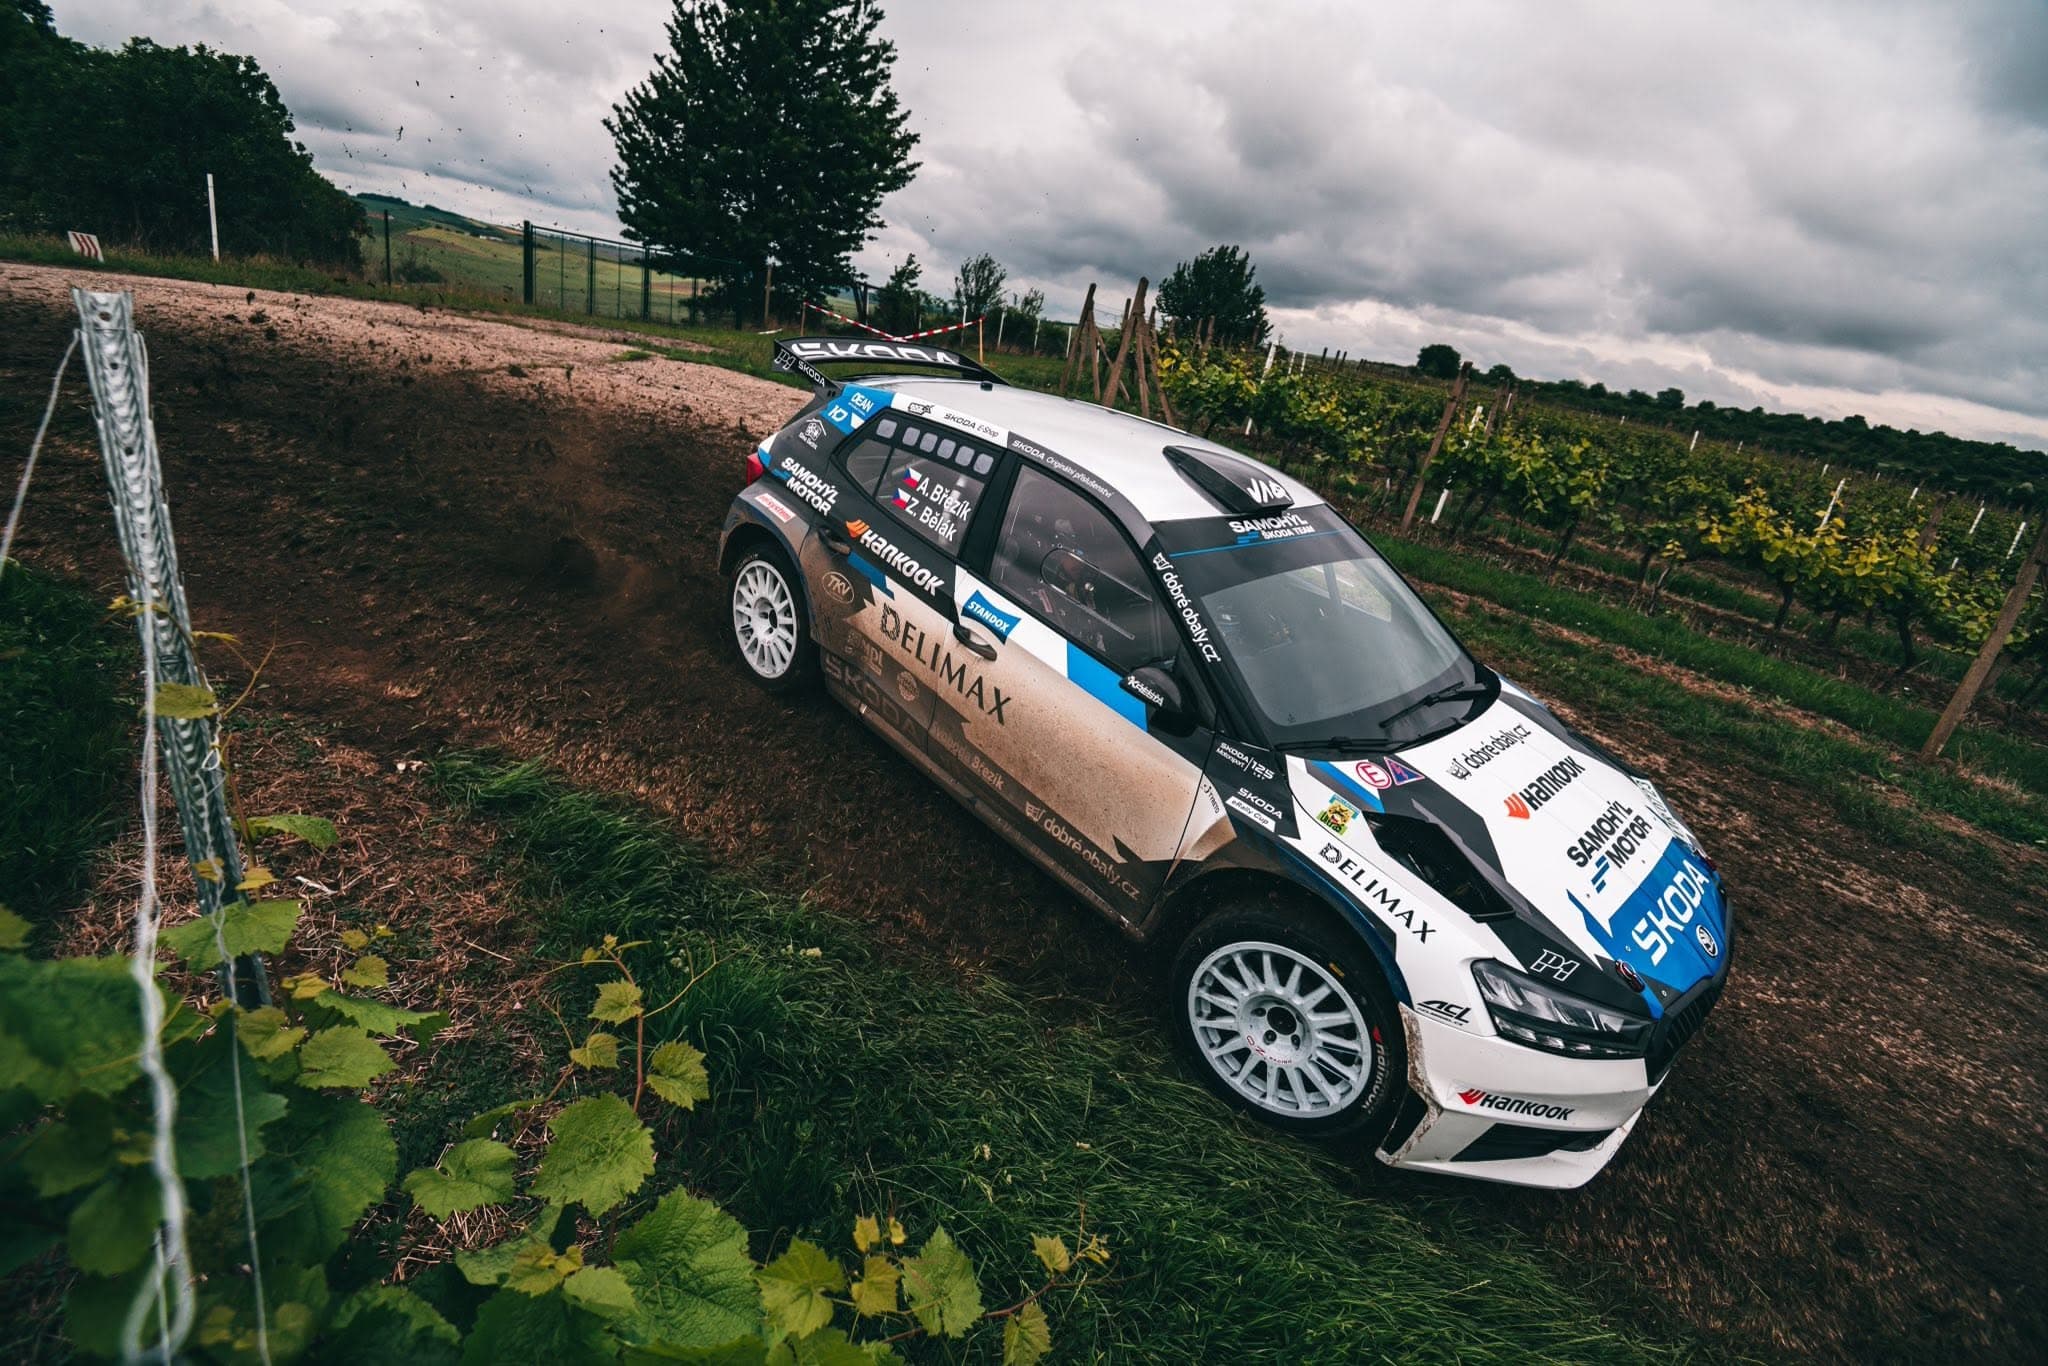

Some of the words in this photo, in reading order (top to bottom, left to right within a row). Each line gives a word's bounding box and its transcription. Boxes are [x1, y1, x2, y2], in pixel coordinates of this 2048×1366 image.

[786, 476, 831, 516] MOTOR
[919, 505, 957, 542] Bělák
[967, 600, 1010, 633] STANDOX
[880, 603, 1012, 726] DELIMAX
[1251, 760, 1275, 780] 125
[1253, 812, 1270, 825] Cup
[1567, 800, 1633, 868] SAMOHÝL
[1605, 815, 1653, 869] MOTOR
[1319, 842, 1437, 944] DELIMAX
